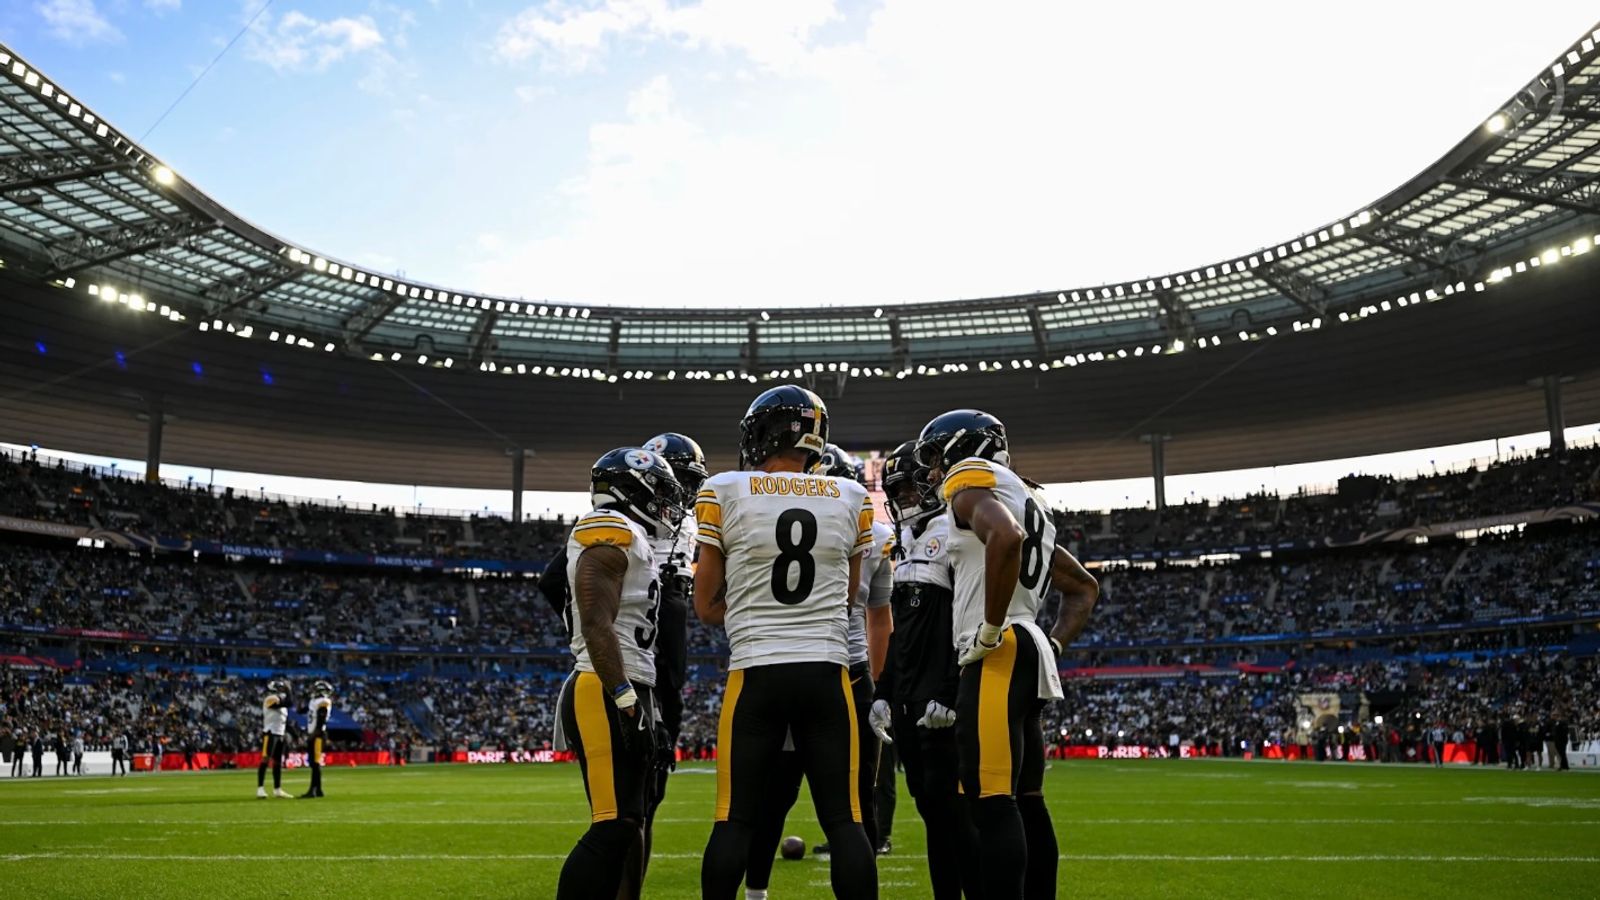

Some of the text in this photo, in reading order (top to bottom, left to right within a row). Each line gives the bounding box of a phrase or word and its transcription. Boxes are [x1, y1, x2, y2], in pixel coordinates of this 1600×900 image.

[750, 476, 840, 498] RODGERS
[222, 544, 251, 556] PARIS
[772, 508, 818, 604] 8
[375, 556, 402, 566] PARIS
